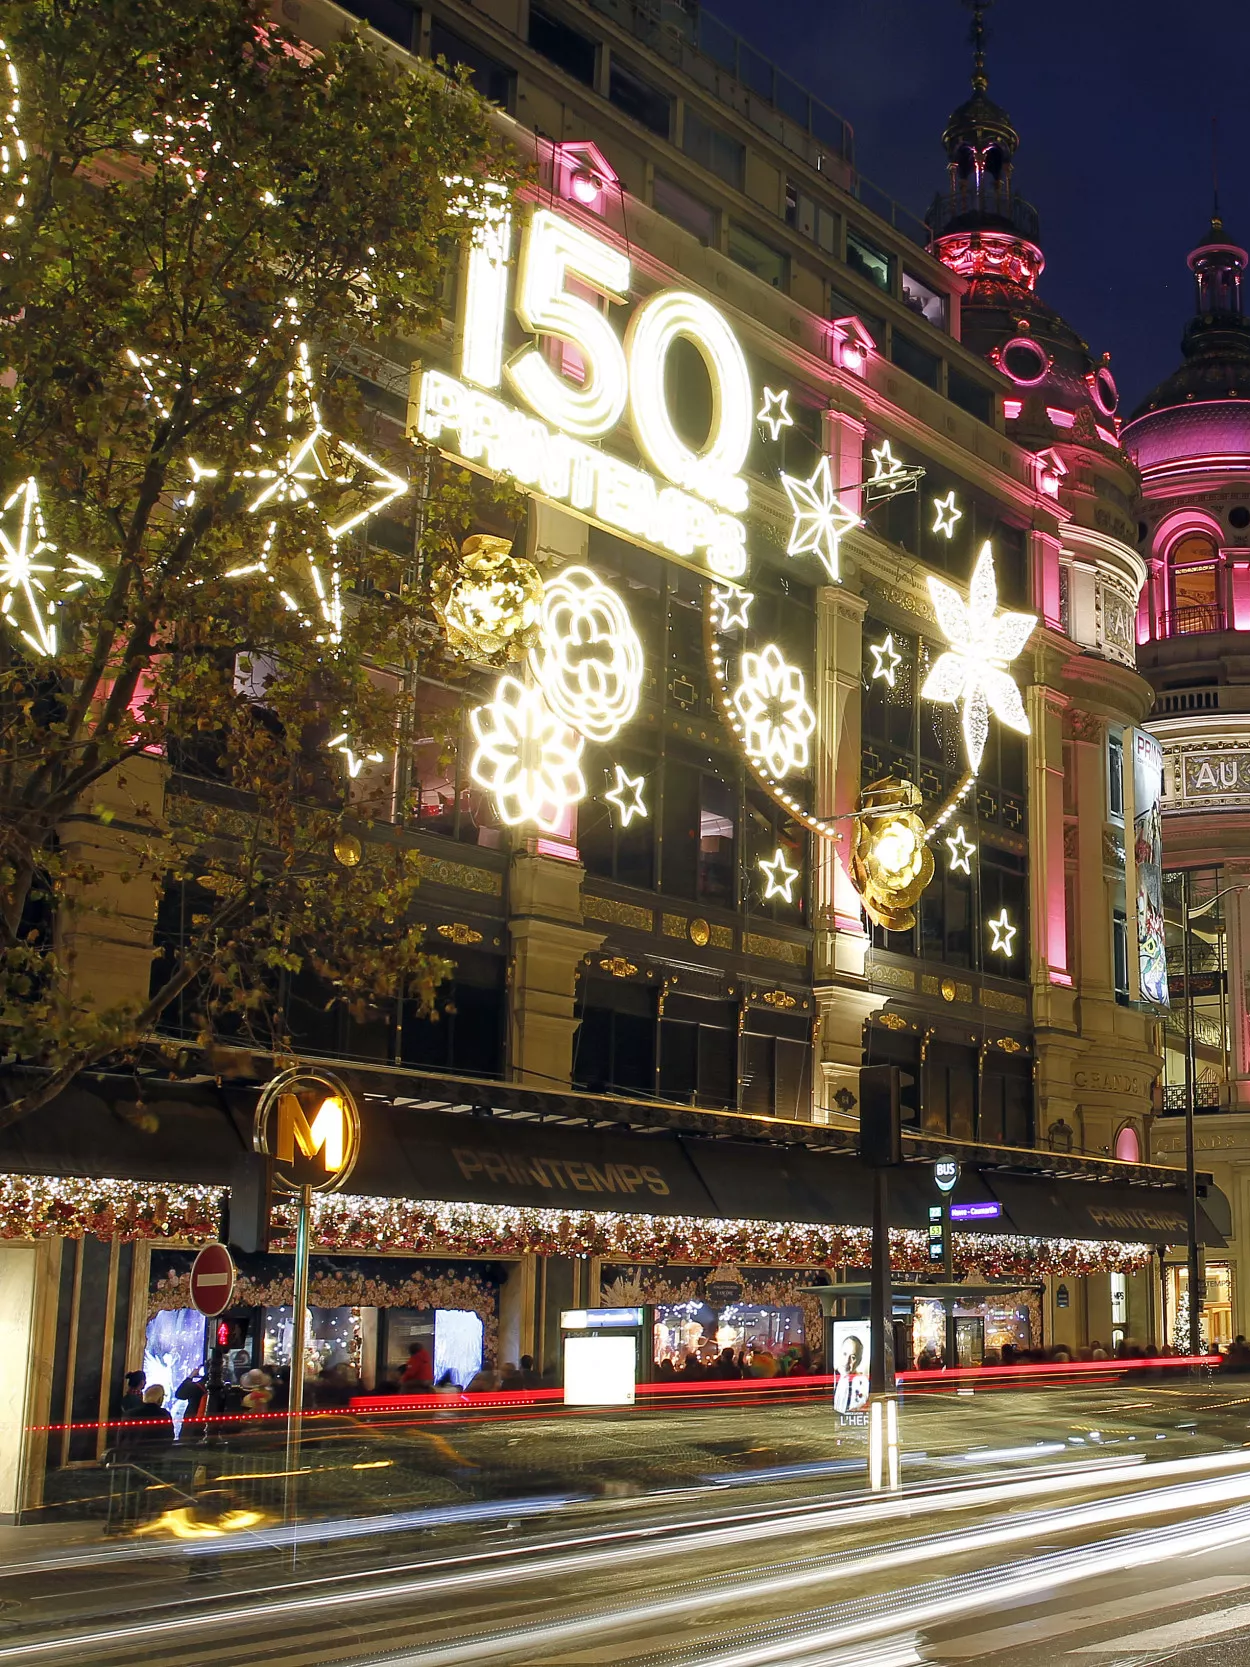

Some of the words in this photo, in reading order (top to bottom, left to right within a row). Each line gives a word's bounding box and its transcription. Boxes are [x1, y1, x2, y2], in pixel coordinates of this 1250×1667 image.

[446, 176, 753, 488] 150
[1196, 761, 1238, 788] AU
[1074, 1071, 1138, 1095] GRANDS
[277, 1093, 345, 1174] M
[1156, 1134, 1236, 1150] GRNDS
[452, 1148, 670, 1196] PRINTEMPS
[936, 1162, 956, 1176] BUS
[931, 1227, 940, 1235] 53
[1087, 1204, 1189, 1232] PRINTEMPS
